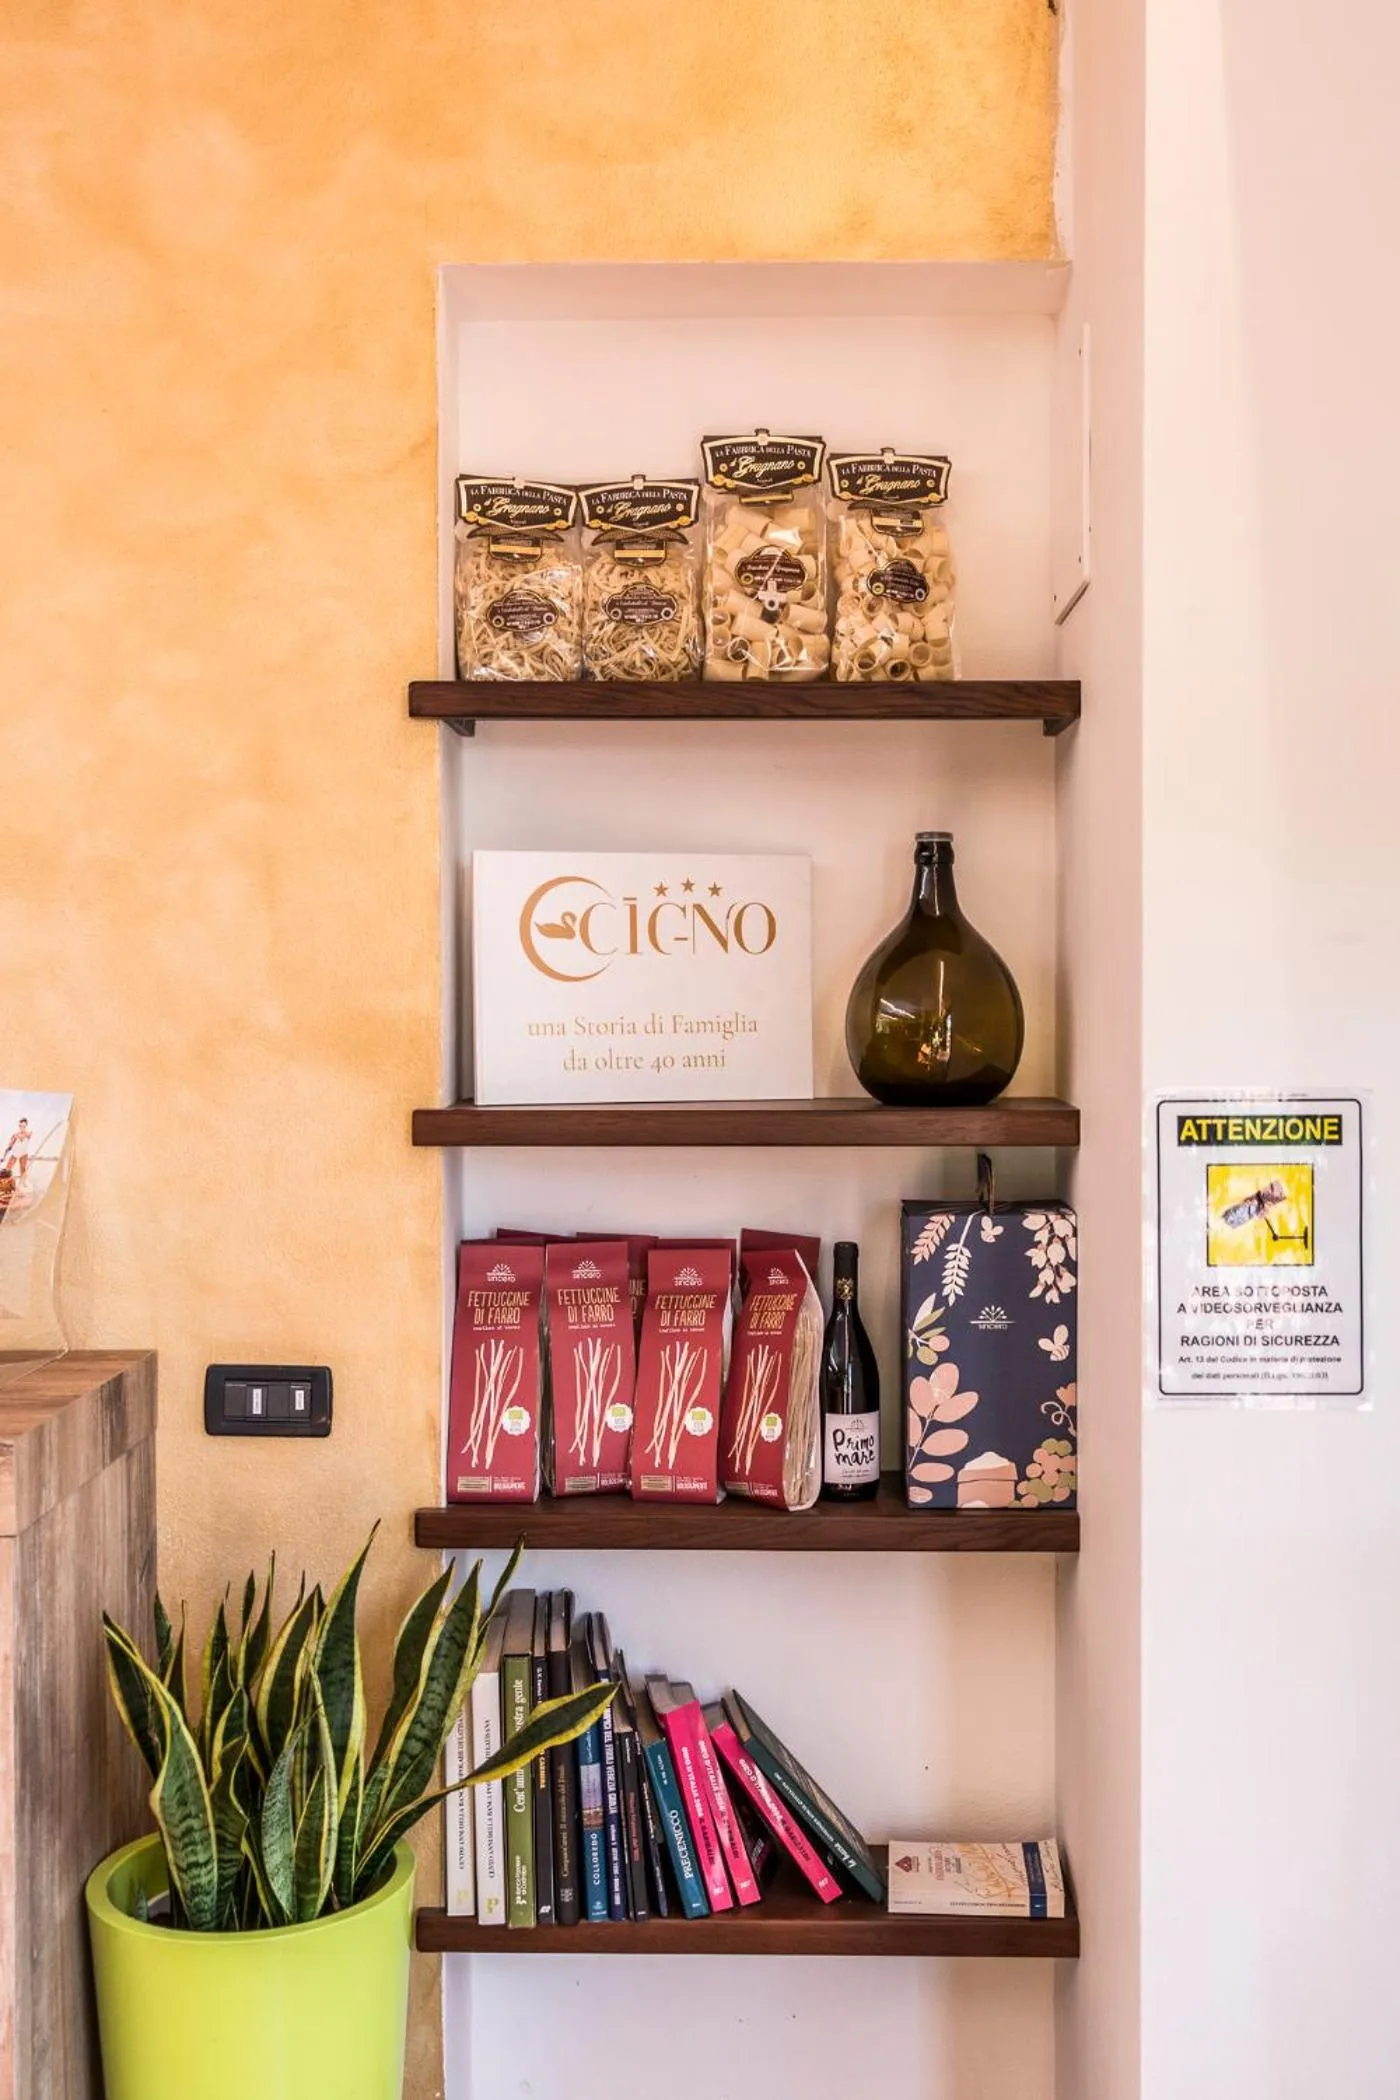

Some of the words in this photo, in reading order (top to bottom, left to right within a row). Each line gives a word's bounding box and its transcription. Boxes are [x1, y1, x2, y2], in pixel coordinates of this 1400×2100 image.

[724, 445, 764, 456] FABBRICA
[787, 445, 811, 457] PASTA
[732, 455, 795, 478] Gragnano
[851, 463, 890, 474] FABBRICA
[912, 464, 937, 478] PASTA
[859, 474, 921, 495] Gragnano
[480, 485, 520, 496] FABBRICA
[542, 491, 567, 506] PASTA
[601, 490, 640, 503] FABBRICA
[663, 488, 688, 501] PASTA
[486, 496, 550, 519] Gragnano
[609, 501, 672, 522] Gragnano
[528, 1019, 566, 1037] una
[573, 1015, 638, 1036] Storia
[643, 1013, 664, 1035] di
[671, 1012, 759, 1040] Famiglia
[562, 1049, 588, 1072] da
[594, 1048, 645, 1072] oltre
[650, 1056, 676, 1074] 40
[681, 1051, 726, 1070] anni
[1179, 1118, 1340, 1142] ATTENZIONE
[467, 1291, 531, 1308] FETTUCCINE
[556, 1287, 621, 1305] FETTUCCINE
[1191, 1285, 1230, 1297] AREA
[655, 1294, 717, 1310] FETTUCCINE
[750, 1294, 798, 1311] FETTUCCINE
[1177, 1303, 1187, 1314] A
[1191, 1302, 1343, 1314] VIDEOSORVEGLIANZA
[474, 1308, 484, 1325] DI
[488, 1307, 521, 1325] FARRO
[567, 1306, 578, 1323] DI
[581, 1305, 614, 1322] FARRO
[660, 1311, 671, 1327] DI
[674, 1310, 706, 1327] FARRO
[750, 1312, 760, 1329] DI
[760, 1311, 786, 1329] FARRO
[1246, 1318, 1274, 1330] PER
[1180, 1335, 1240, 1346] RAGIONI
[1243, 1335, 1257, 1346] DI
[1261, 1335, 1341, 1346] SICUREZZA
[832, 1428, 875, 1452] Primo
[834, 1449, 877, 1466] mare
[512, 1679, 526, 1704] gente
[605, 1744, 615, 1765] FRIULI
[681, 1746, 691, 1767] GIRO
[686, 1766, 699, 1799] D'ITALIA
[698, 1740, 708, 1760] GIRO
[704, 1757, 718, 1792] D'ITALIA
[739, 1758, 752, 1776] GIRO
[606, 1765, 616, 1791] VENEZIA
[608, 1792, 617, 1814] GIULIA
[669, 1809, 694, 1880] PRECENICCO
[590, 1832, 600, 1886] COLLOREDO
